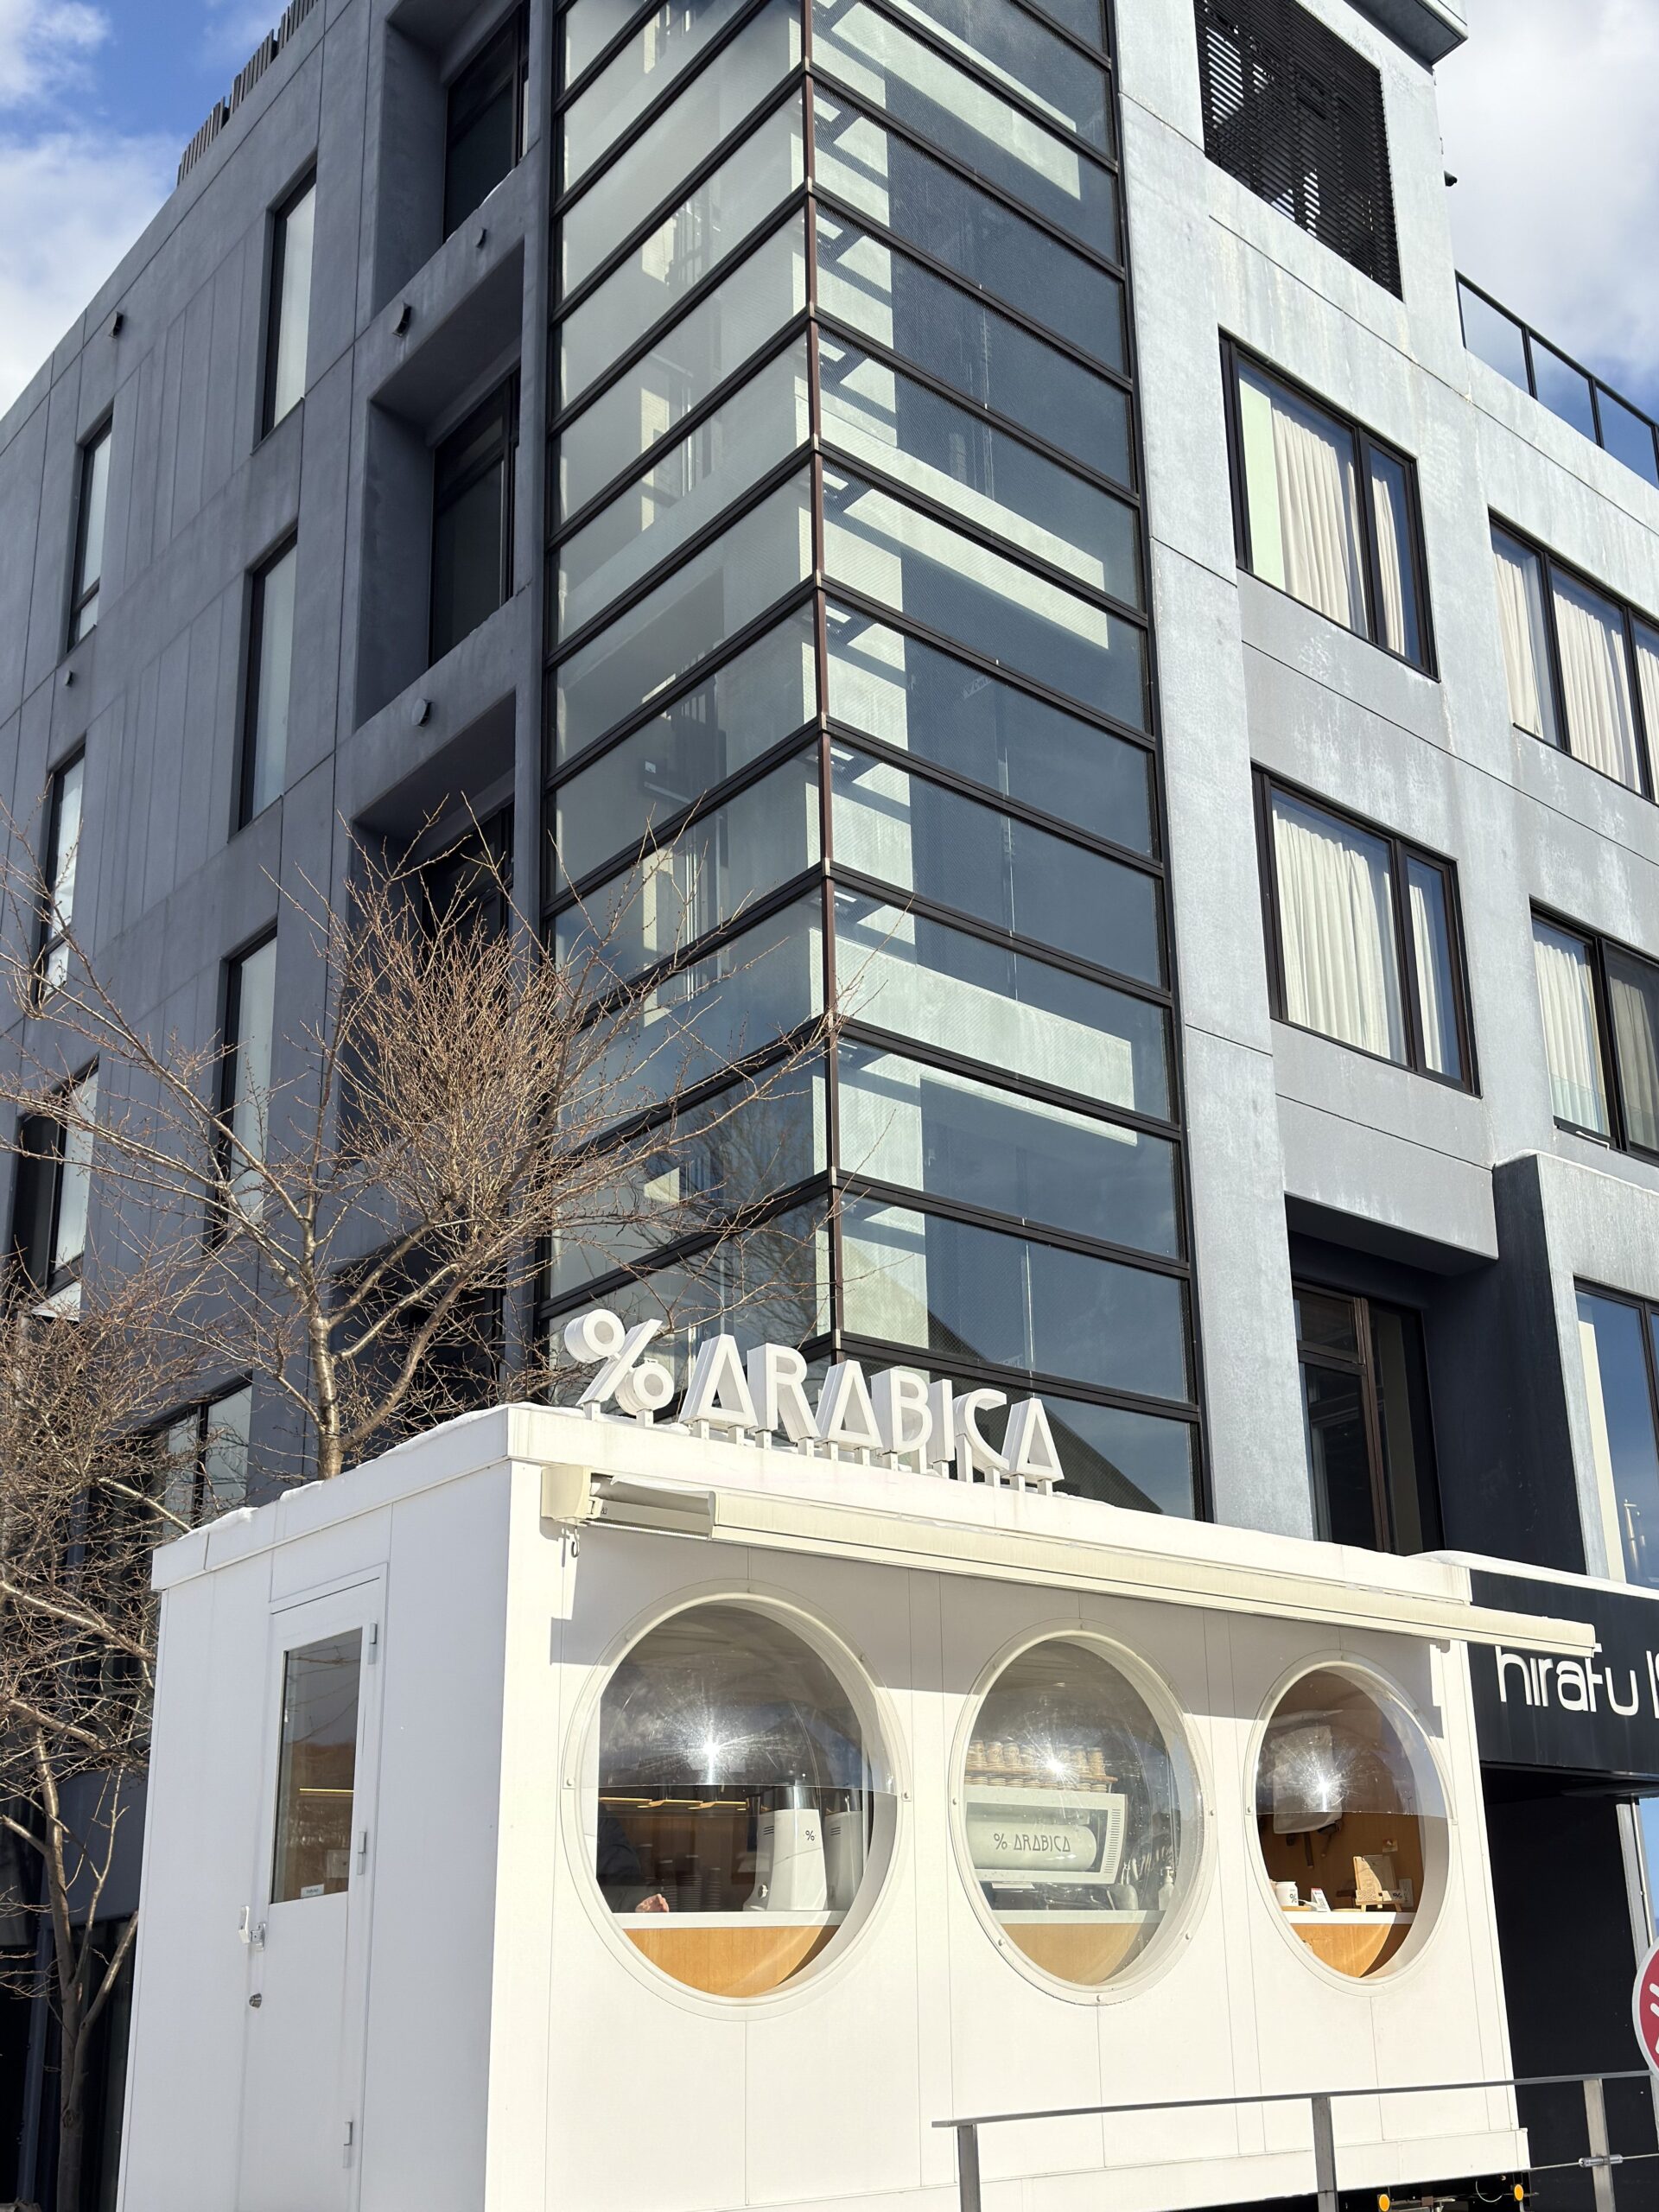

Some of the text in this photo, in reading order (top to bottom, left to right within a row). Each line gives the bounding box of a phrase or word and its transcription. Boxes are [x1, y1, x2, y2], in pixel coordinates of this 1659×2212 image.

[564, 1308, 1065, 1481] % ARABICA
[1495, 1643, 1639, 1716] hirafu
[994, 1833, 1071, 1853] % ARABICA
